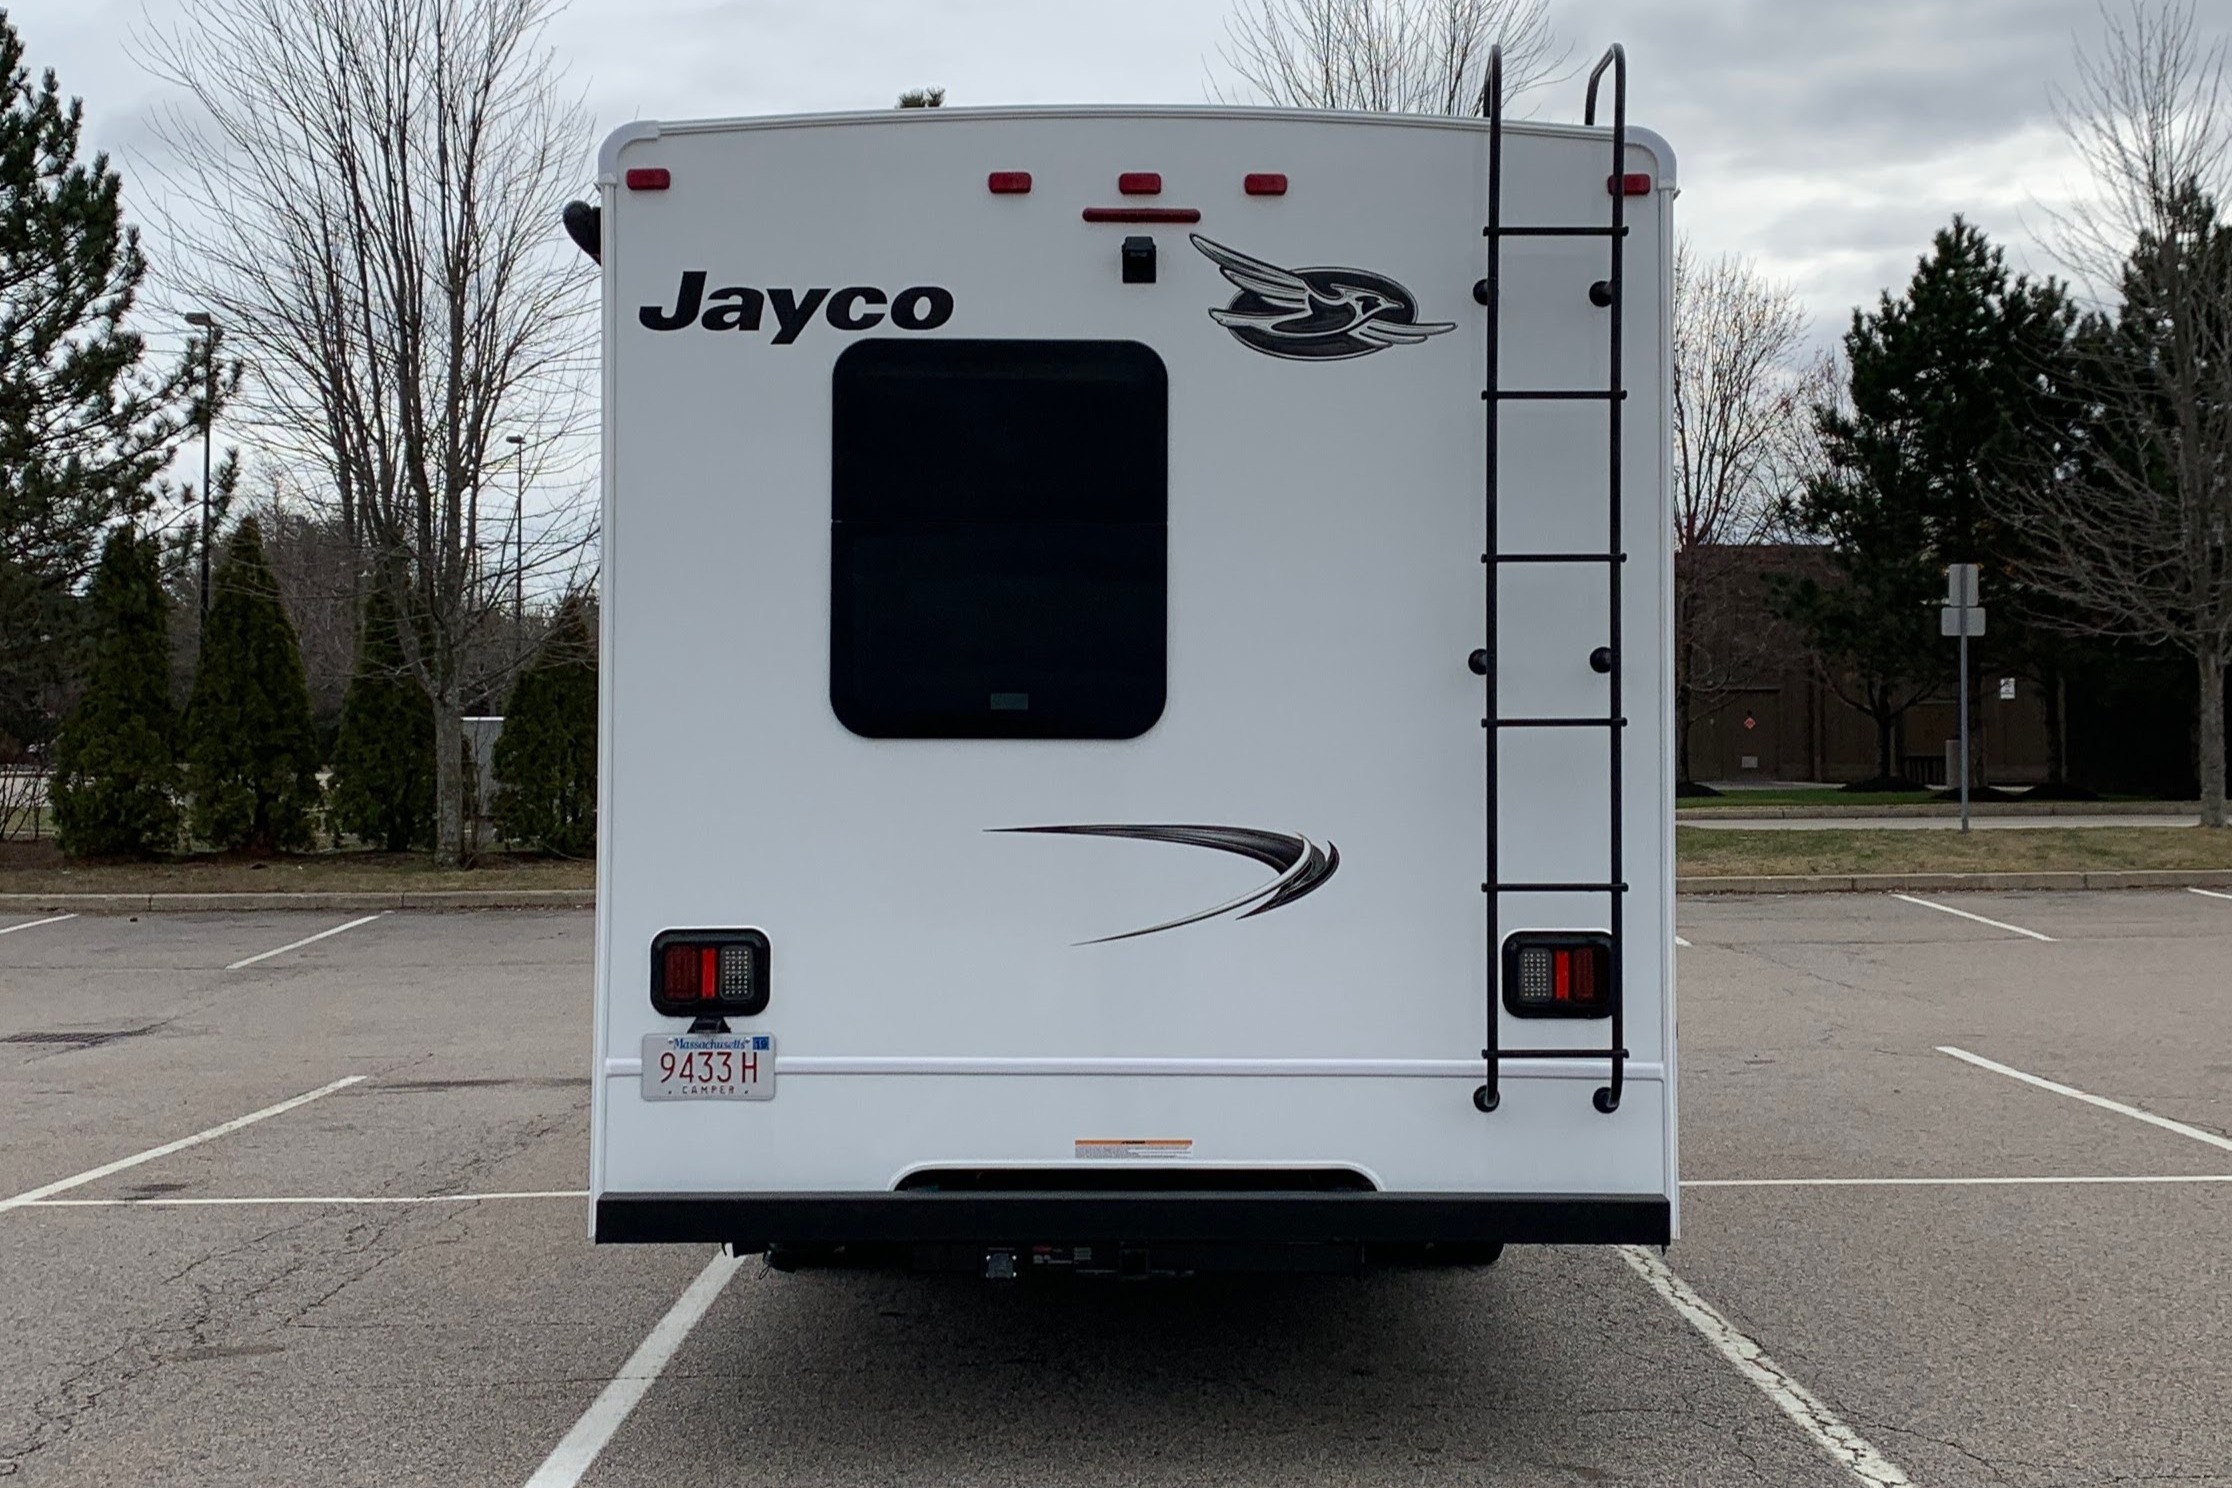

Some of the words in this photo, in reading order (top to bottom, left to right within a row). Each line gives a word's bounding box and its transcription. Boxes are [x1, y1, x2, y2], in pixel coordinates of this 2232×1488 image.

[639, 271, 954, 344] Jayco
[673, 1037, 747, 1050] Massachusetts
[660, 1052, 732, 1083] 9433
[741, 1052, 757, 1083] H
[682, 1085, 735, 1095] CAMPER
